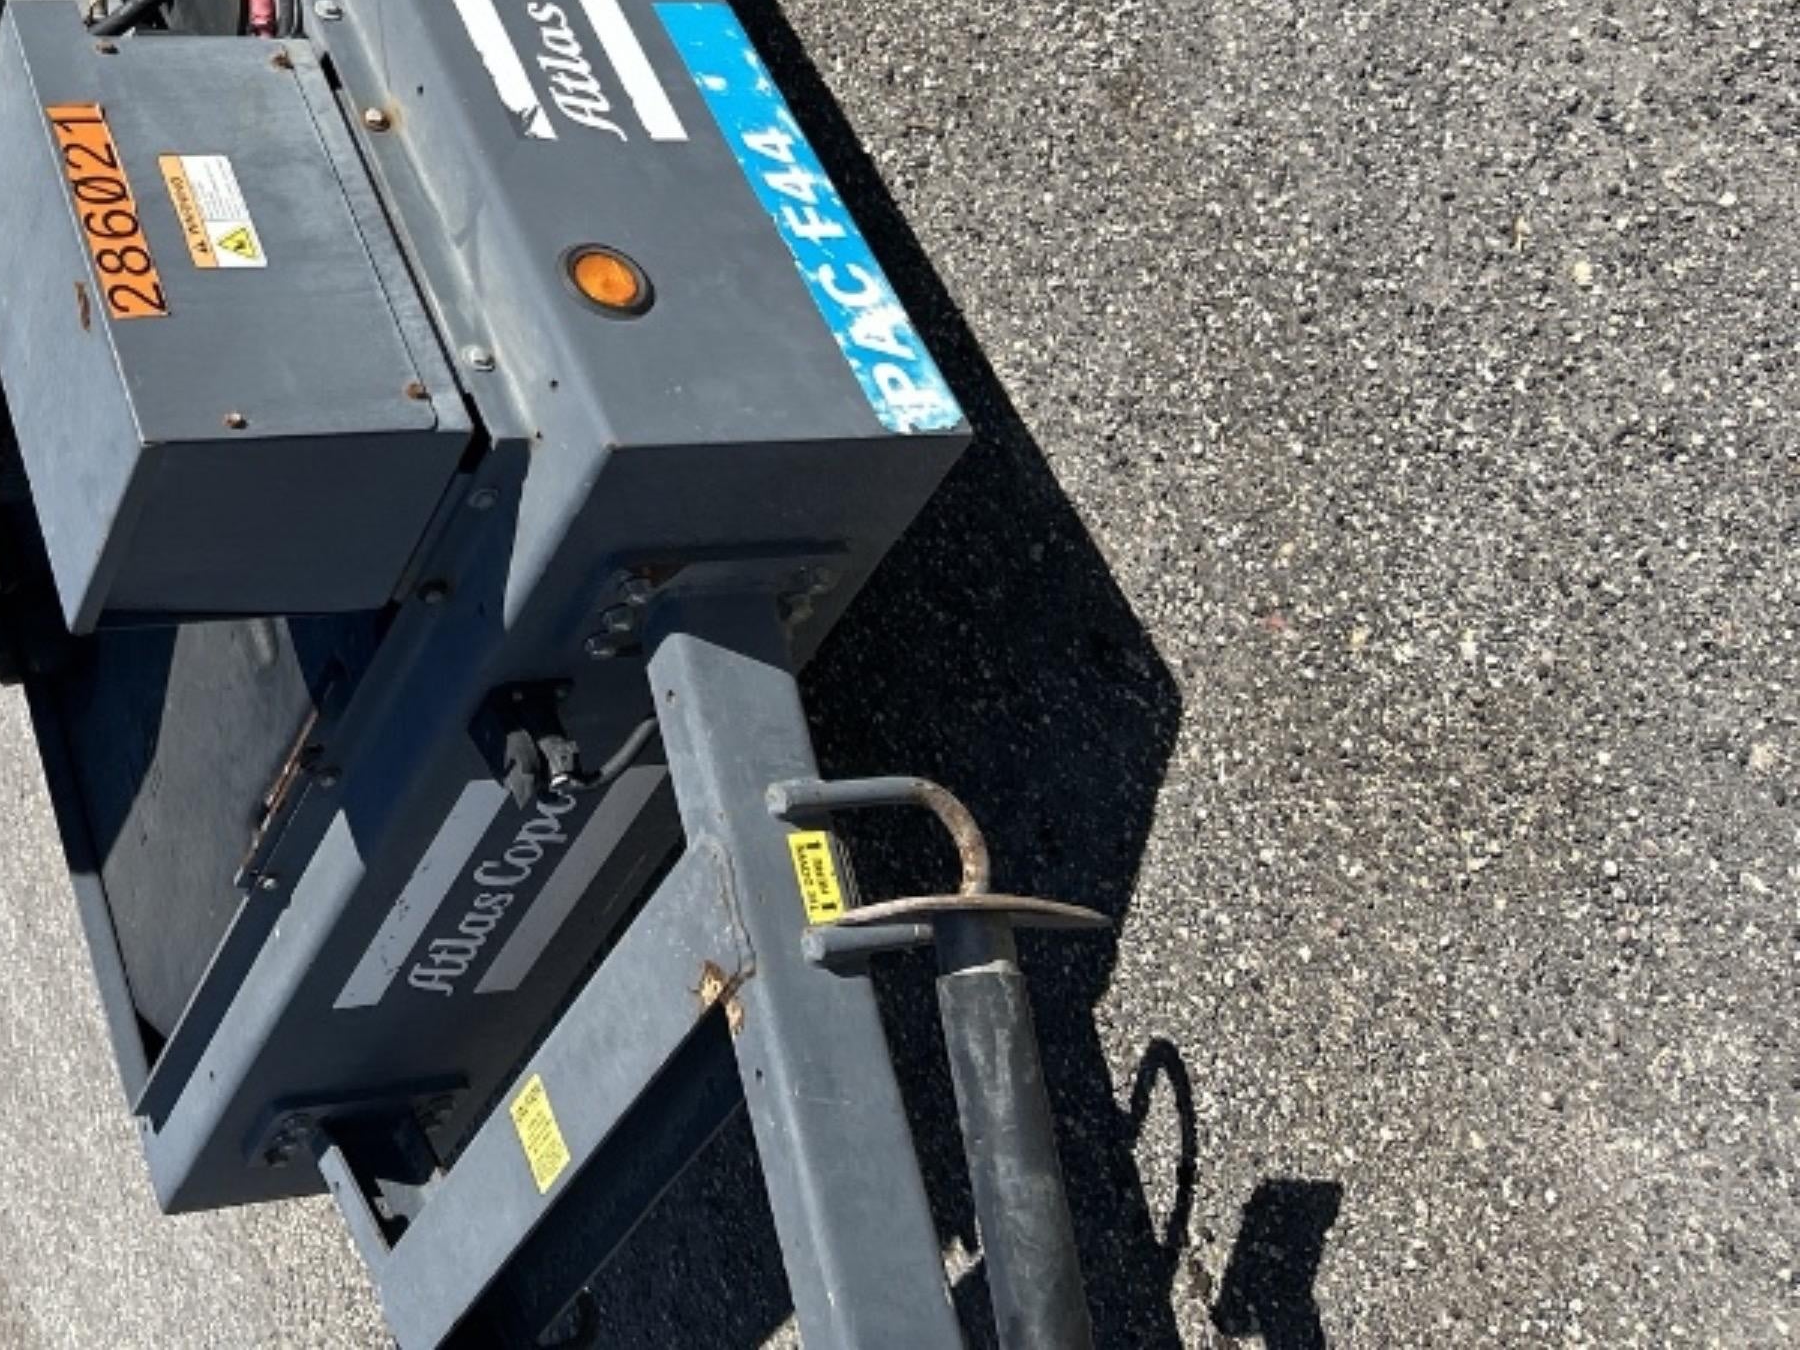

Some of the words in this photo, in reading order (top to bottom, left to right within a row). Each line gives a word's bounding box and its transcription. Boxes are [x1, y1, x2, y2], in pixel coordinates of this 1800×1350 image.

[526, 1, 628, 142] Atlas
[52, 108, 167, 313] 286021
[741, 127, 847, 242] F44
[818, 263, 945, 408] PAC
[407, 892, 514, 997] Atlas
[473, 788, 577, 887] Copc
